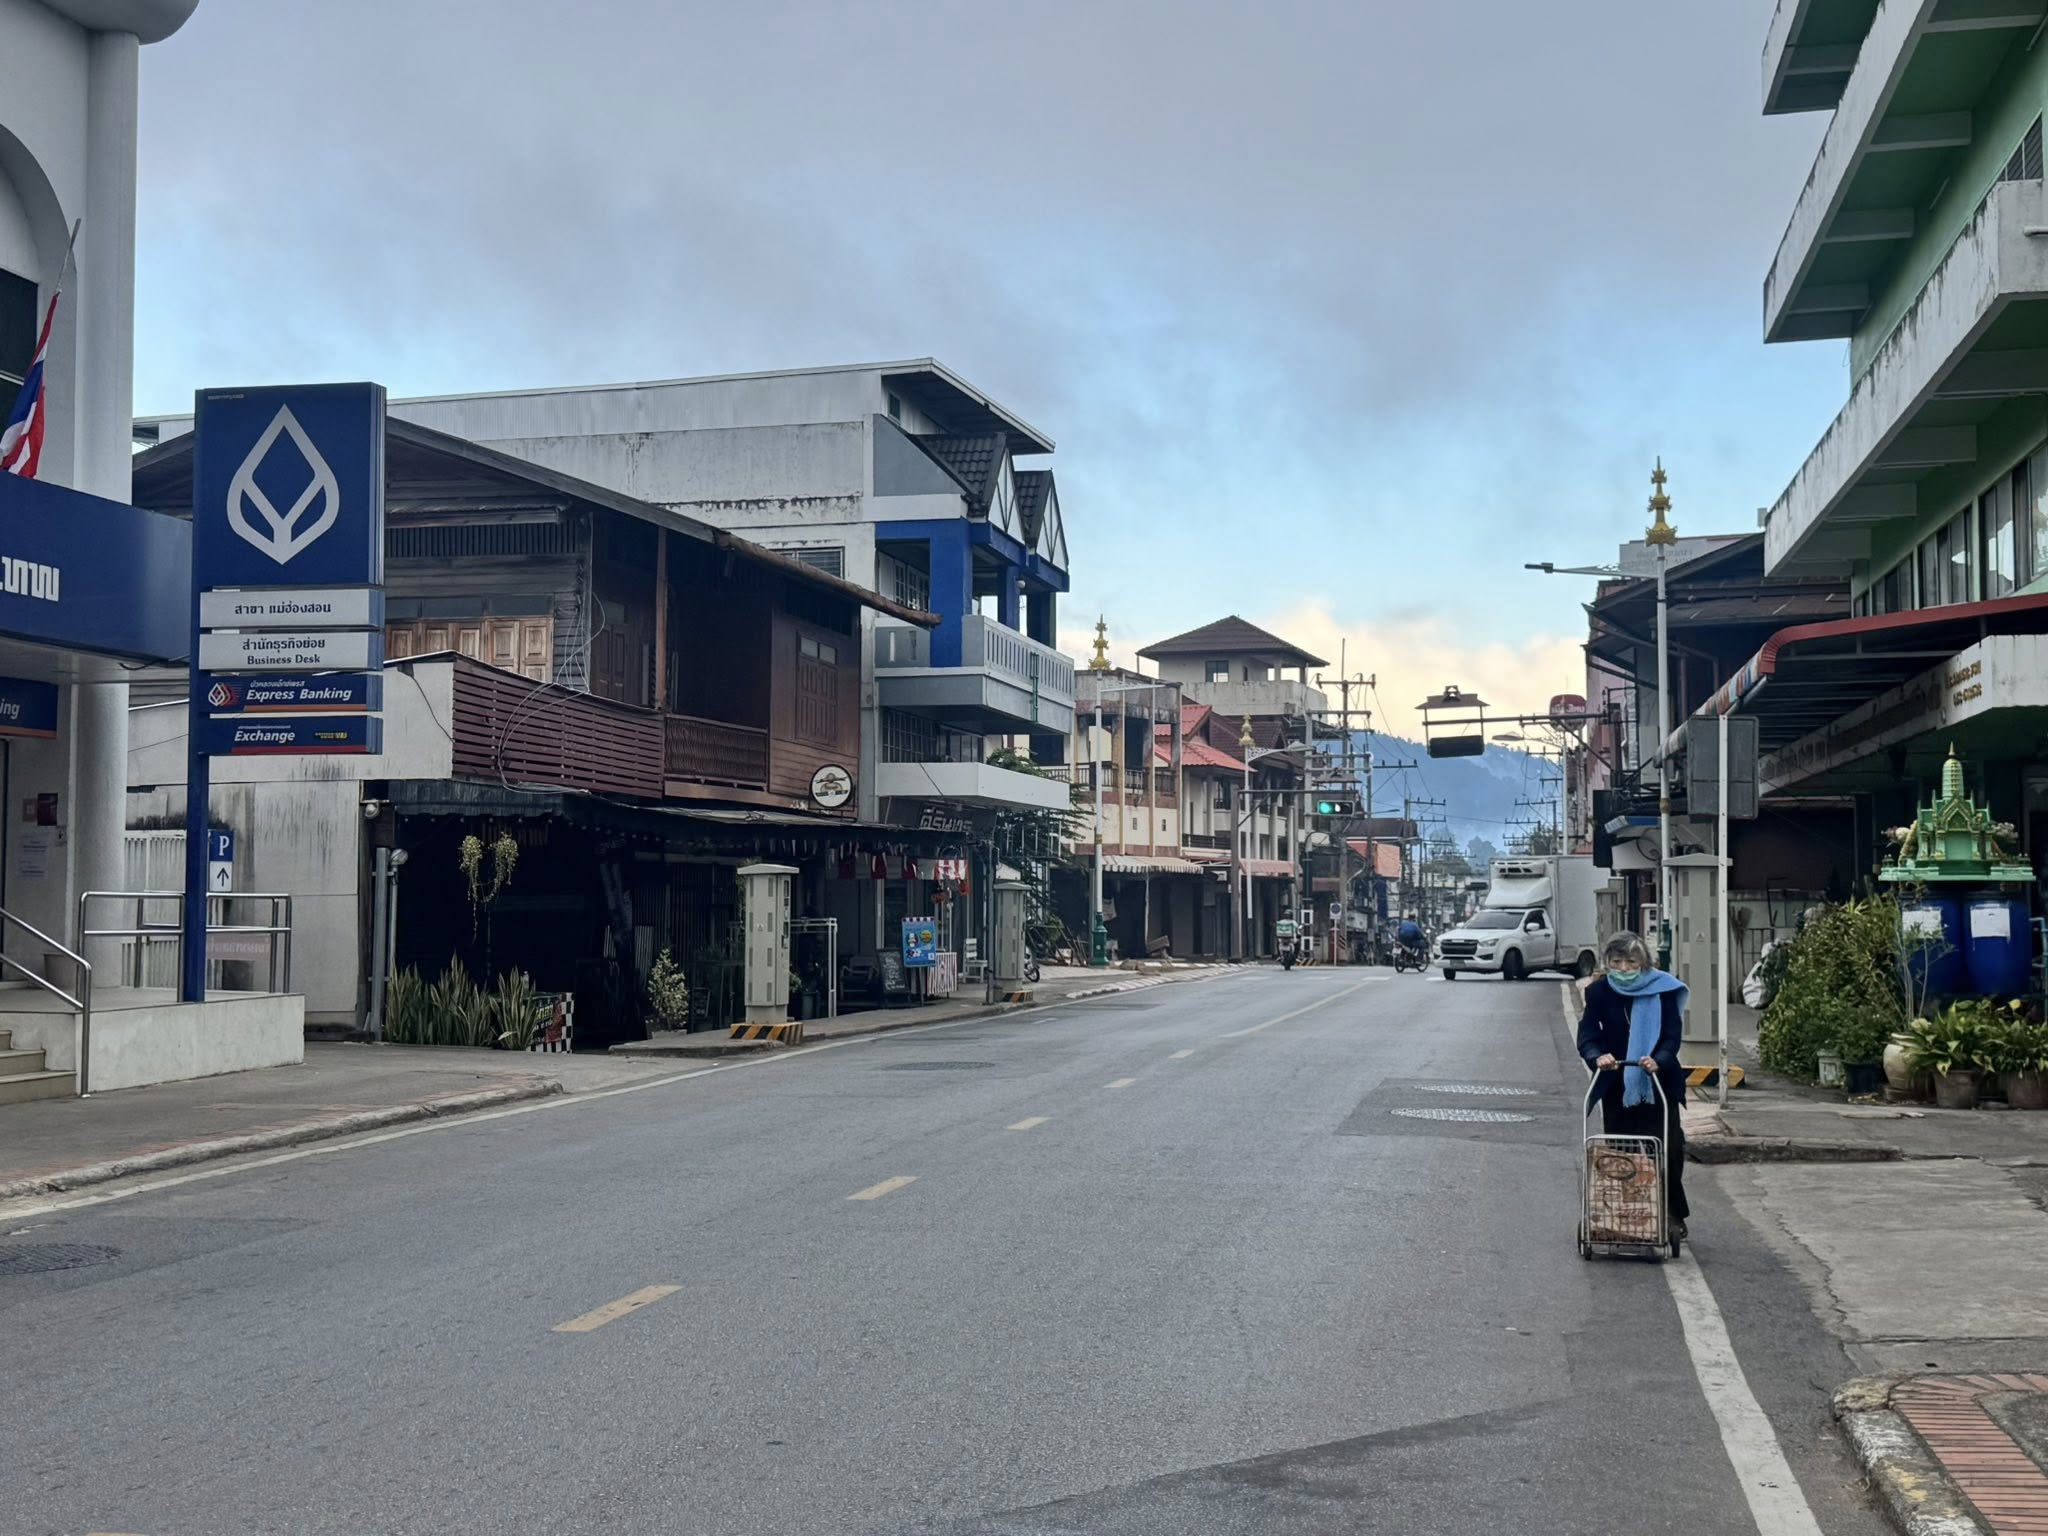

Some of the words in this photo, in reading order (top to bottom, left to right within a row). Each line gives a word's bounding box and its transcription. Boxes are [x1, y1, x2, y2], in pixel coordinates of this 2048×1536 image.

[0, 556, 60, 602] ทพ
[235, 604, 264, 615] สาขา
[269, 600, 331, 614] แม่ฮ่องสอน
[242, 637, 325, 653] สำนักธุรกิจย่อย
[247, 656, 292, 665] Business
[295, 654, 321, 664] Desk
[246, 689, 295, 703] Express
[300, 687, 352, 701] Banking
[234, 730, 295, 744] Exchange
[219, 836, 230, 856] P
